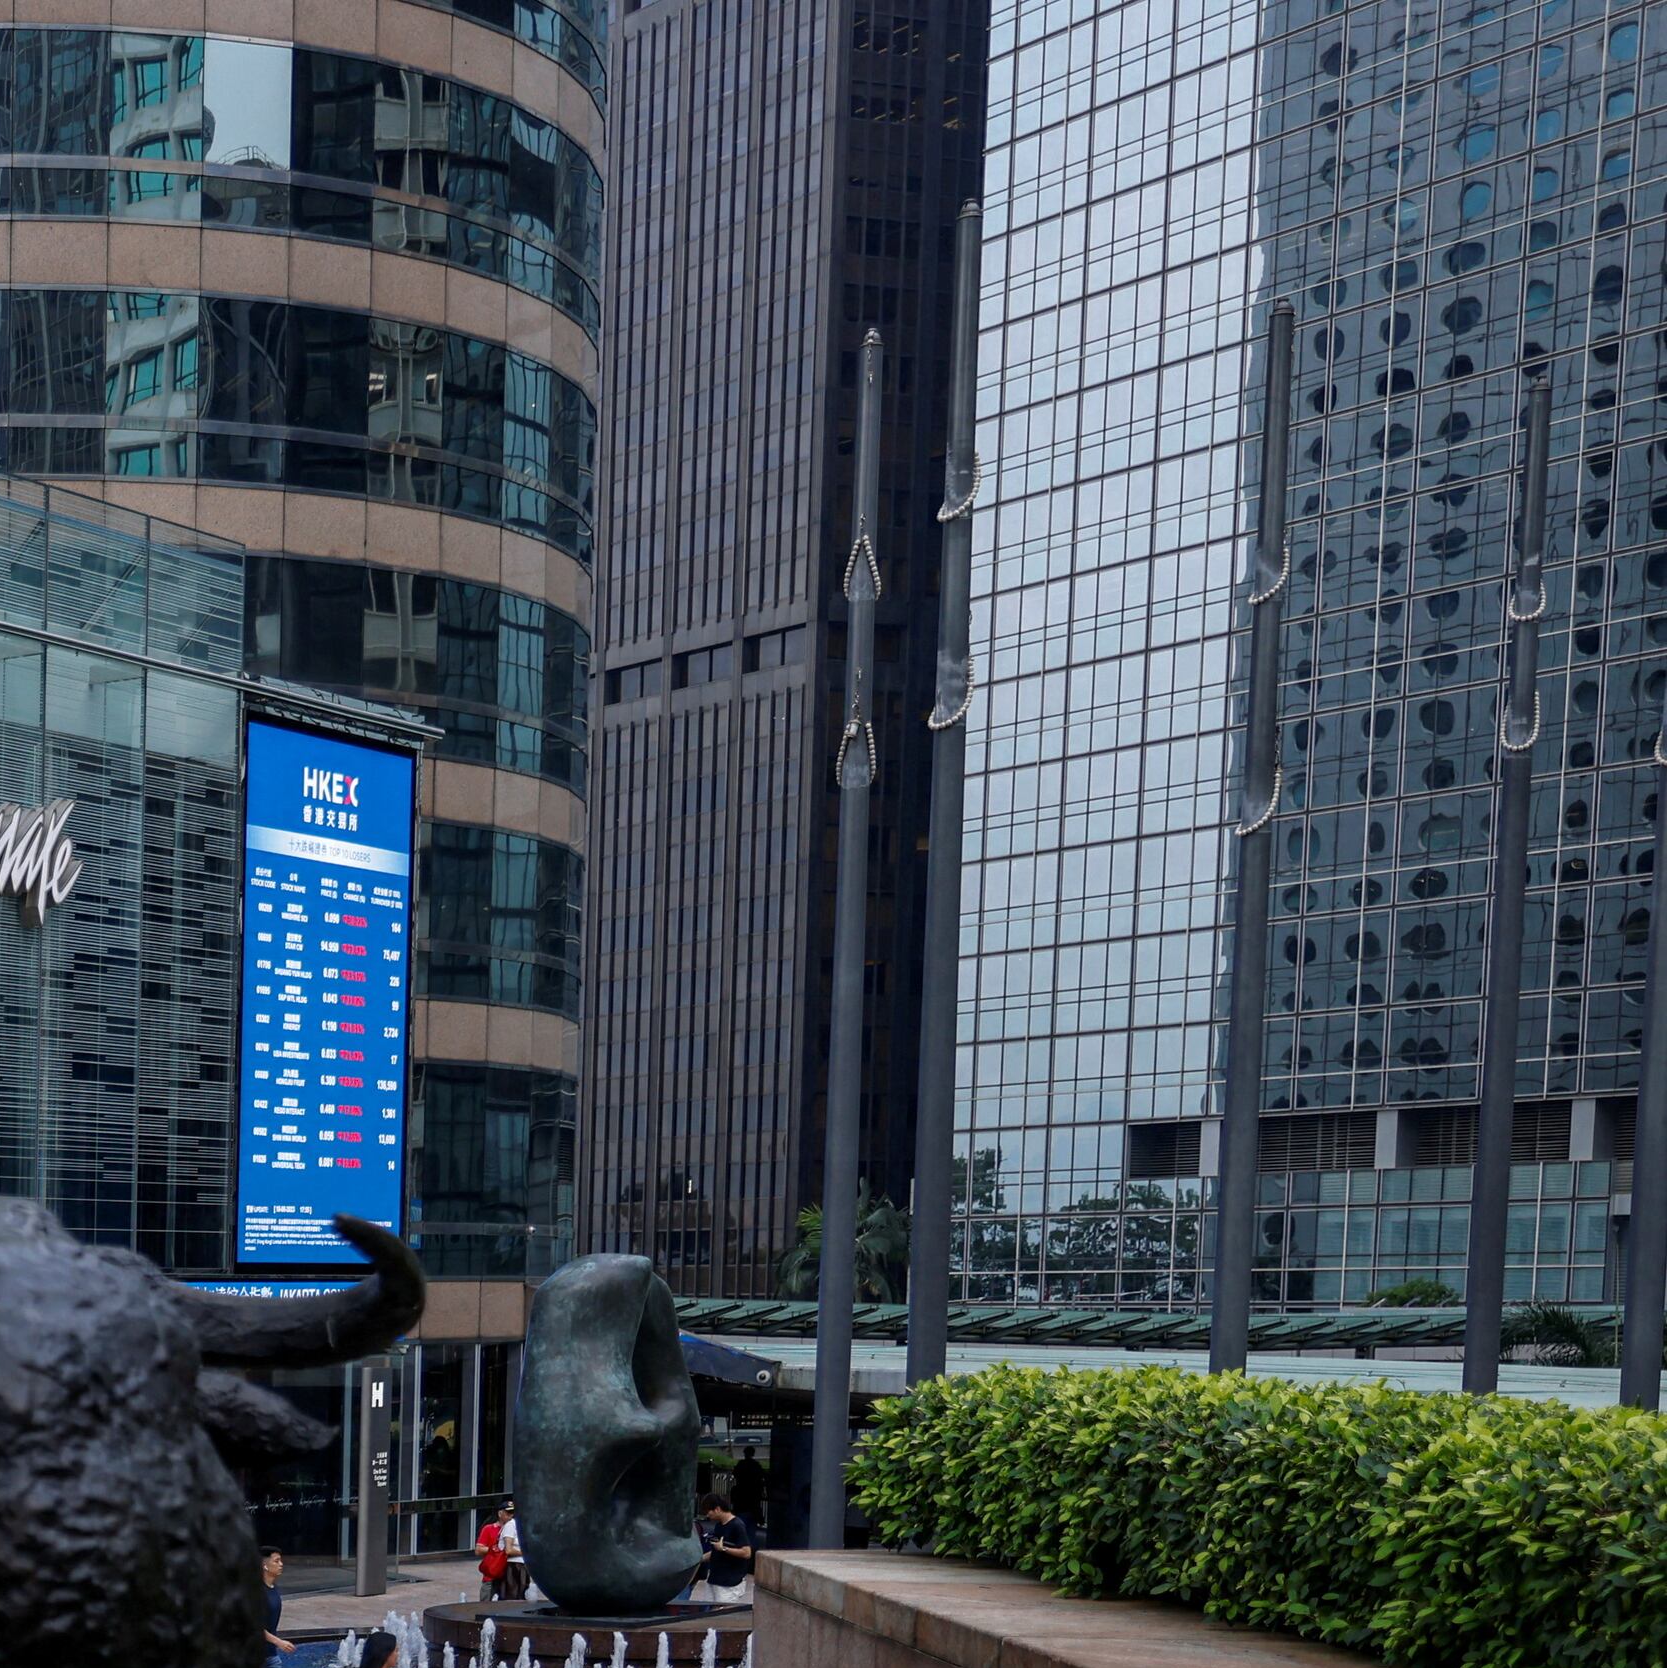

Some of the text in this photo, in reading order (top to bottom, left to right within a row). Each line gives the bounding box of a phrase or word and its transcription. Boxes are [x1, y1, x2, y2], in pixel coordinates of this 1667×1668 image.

[303, 766, 360, 808] HKEX
[303, 805, 359, 832] 香港交易所
